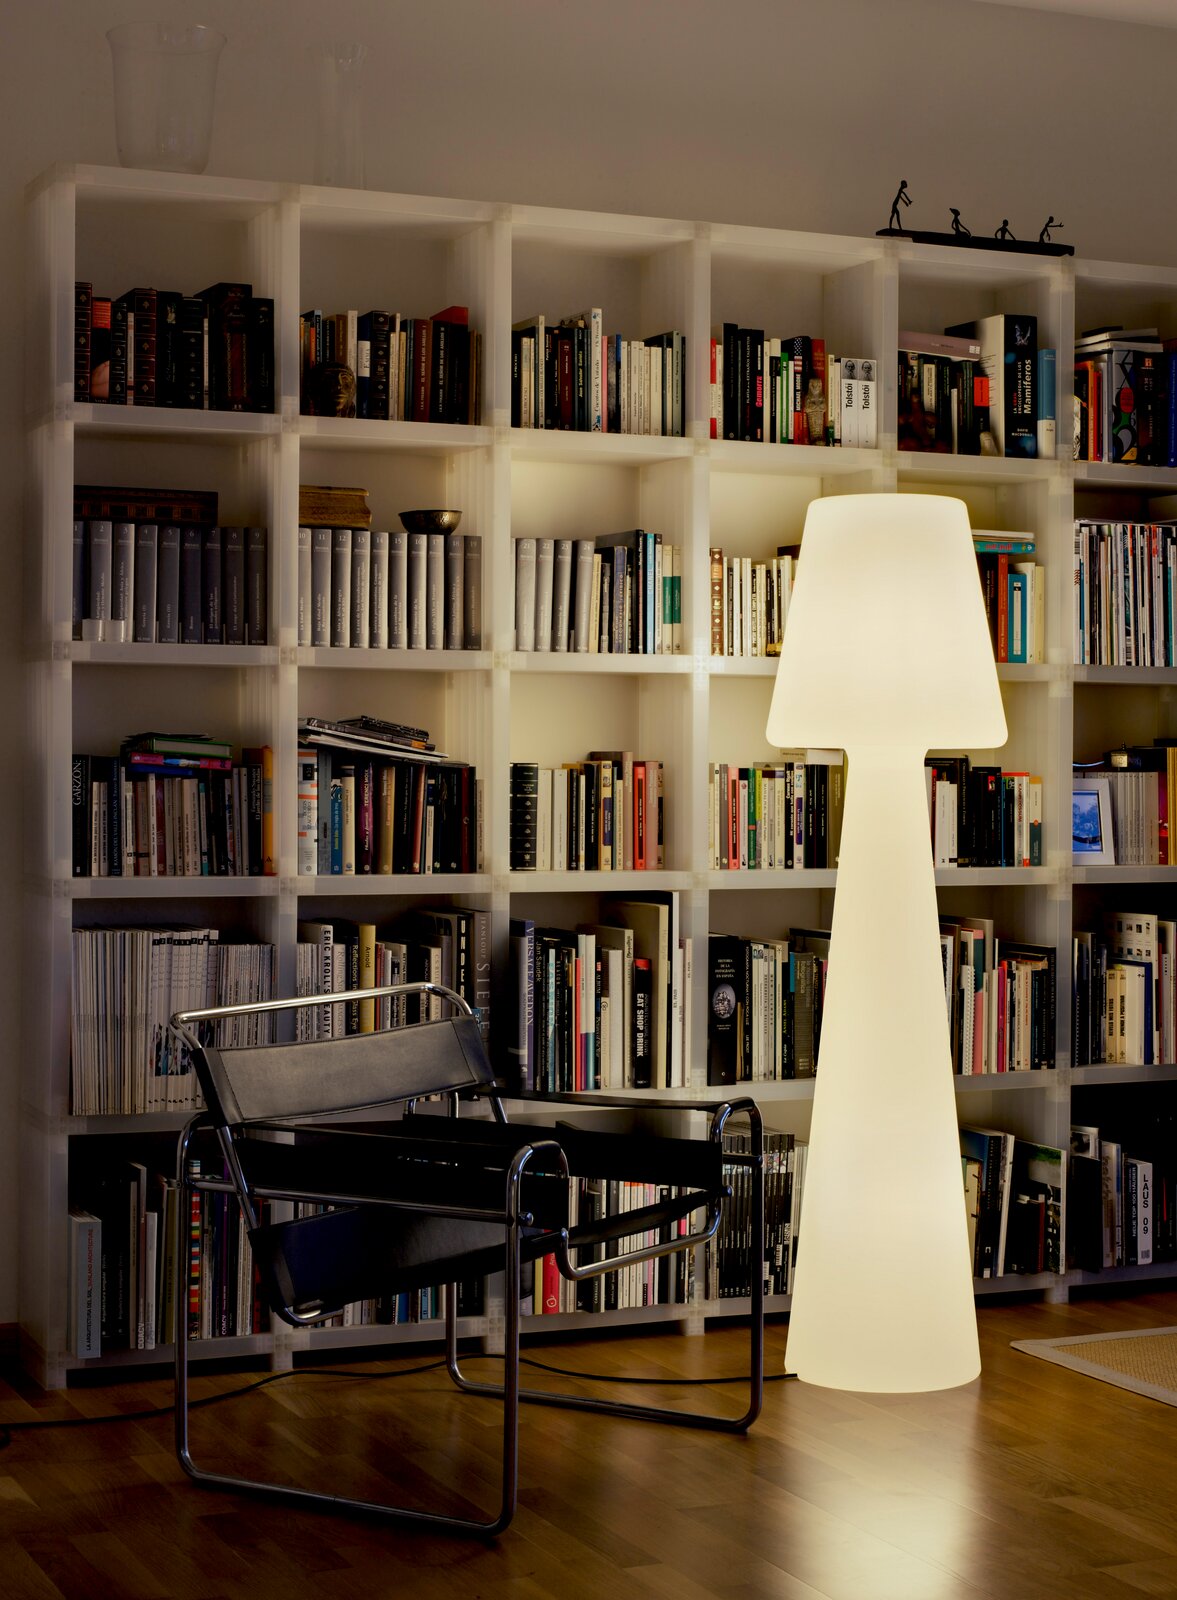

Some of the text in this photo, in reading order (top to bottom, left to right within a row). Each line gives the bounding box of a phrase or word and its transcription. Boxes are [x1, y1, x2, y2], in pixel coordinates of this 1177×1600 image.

[845, 383, 853, 408] Tolstói
[862, 384, 870, 410] Tolstói
[1023, 359, 1032, 414] Mamíferos
[1143, 1218, 1148, 1234] 09
